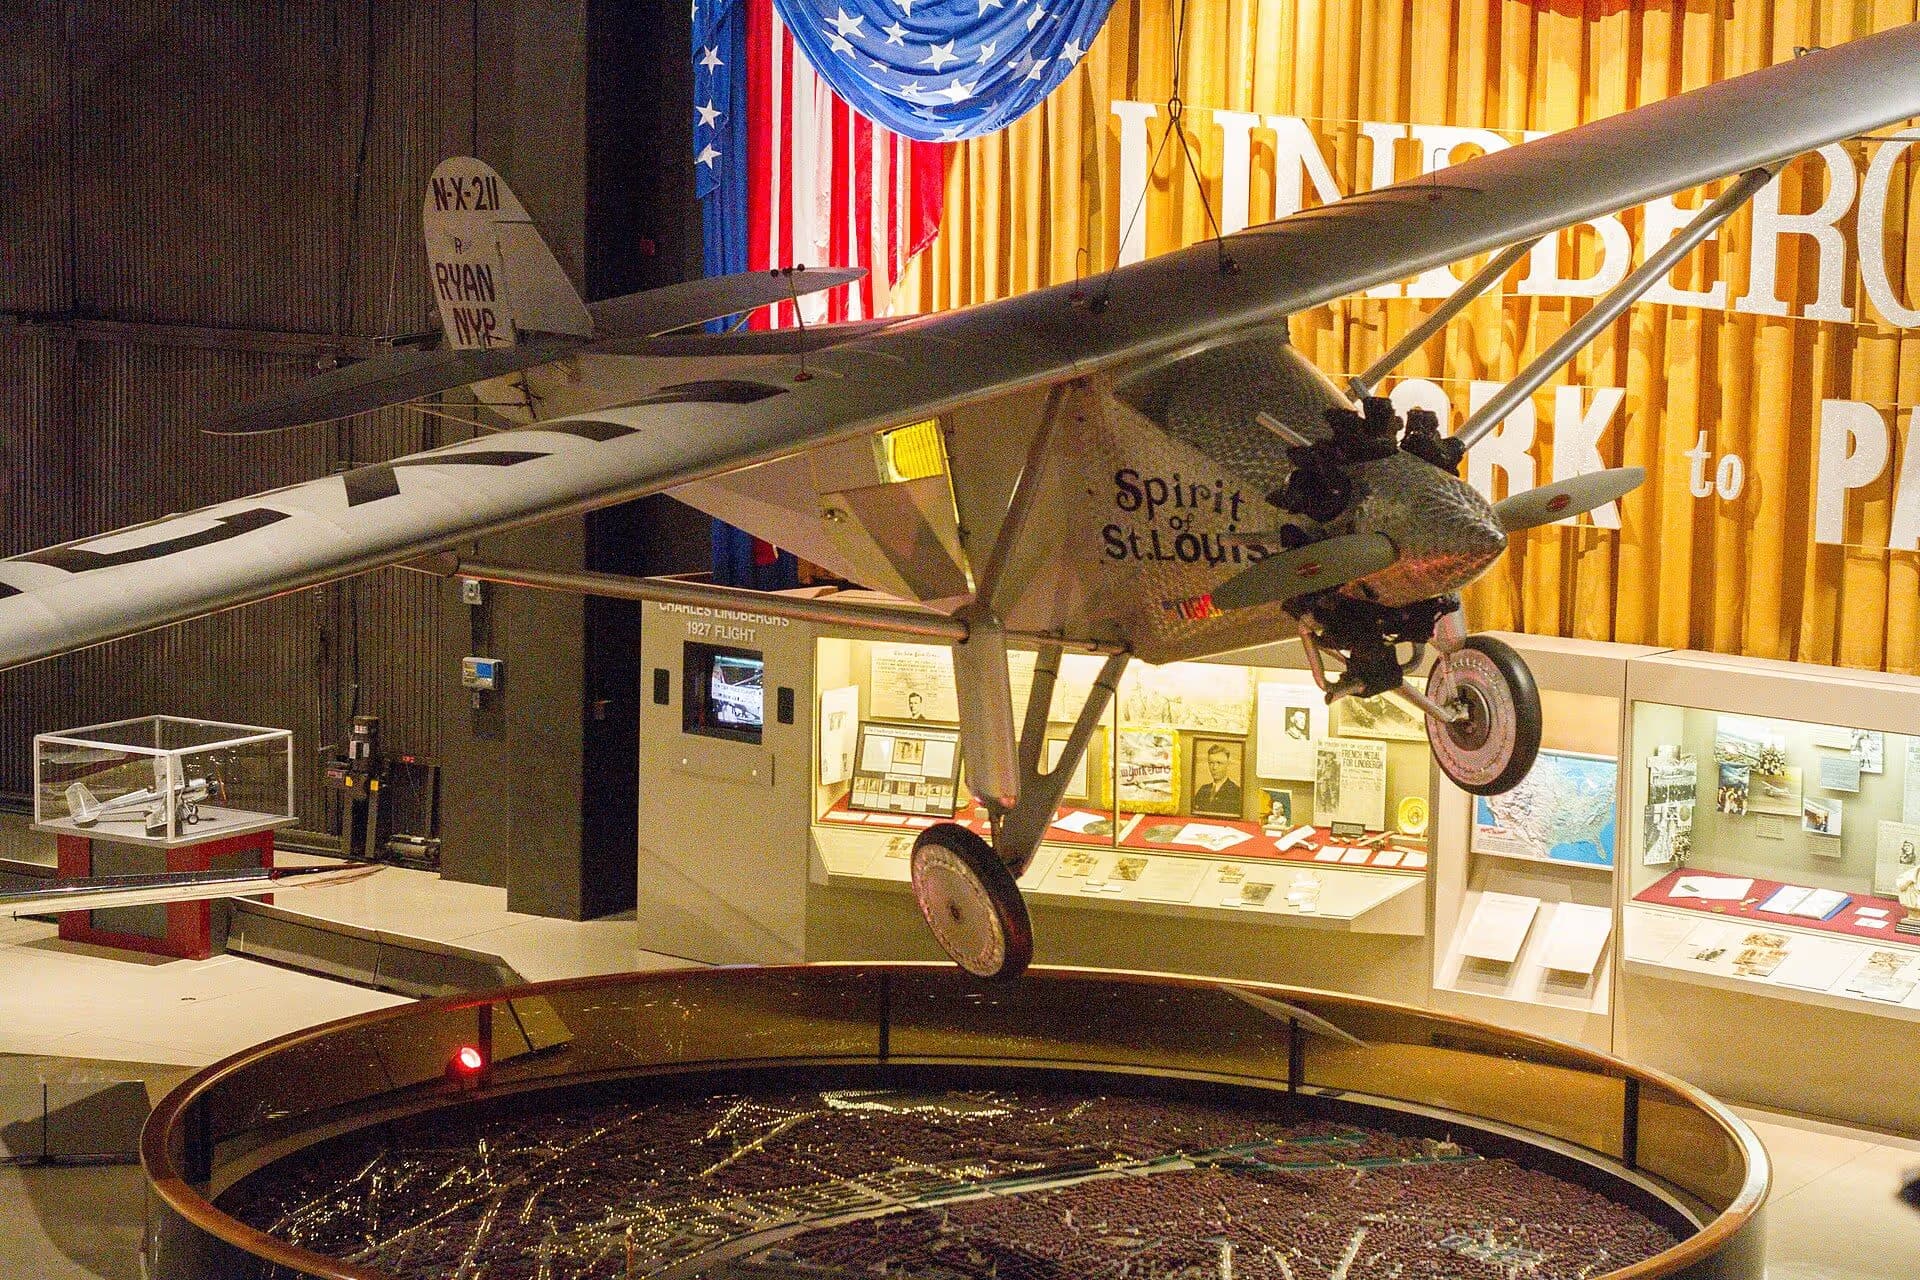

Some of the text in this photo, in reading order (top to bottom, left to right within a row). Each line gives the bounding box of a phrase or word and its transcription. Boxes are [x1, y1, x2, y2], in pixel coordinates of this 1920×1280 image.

[432, 175, 500, 211] N-X-211
[435, 262, 495, 301] RYAN
[453, 307, 496, 346] NYP
[1354, 378, 1625, 530] RK
[1684, 430, 1745, 500] to
[1114, 468, 1244, 521] Spirit
[1169, 513, 1195, 532] of
[659, 602, 712, 616] CHARLES
[687, 621, 756, 641] 1927 FLIGHT
